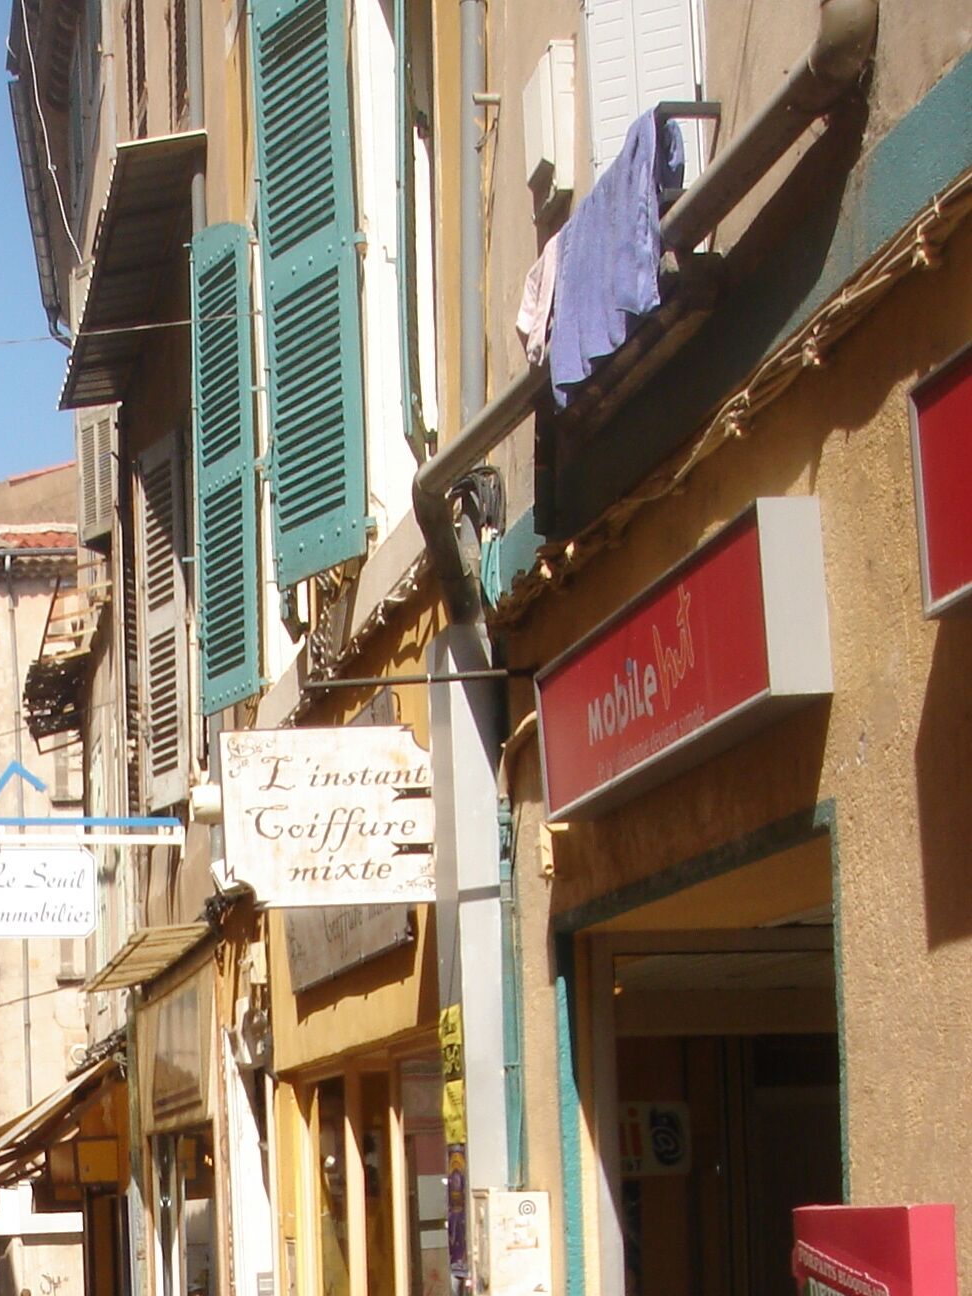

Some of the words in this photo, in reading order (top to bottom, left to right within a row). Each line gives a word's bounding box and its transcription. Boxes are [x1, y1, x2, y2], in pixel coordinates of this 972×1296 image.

[259, 755, 428, 793] L'instant
[245, 804, 417, 853] Coiffure
[24, 861, 86, 889] Seuil
[288, 854, 393, 884] mixte
